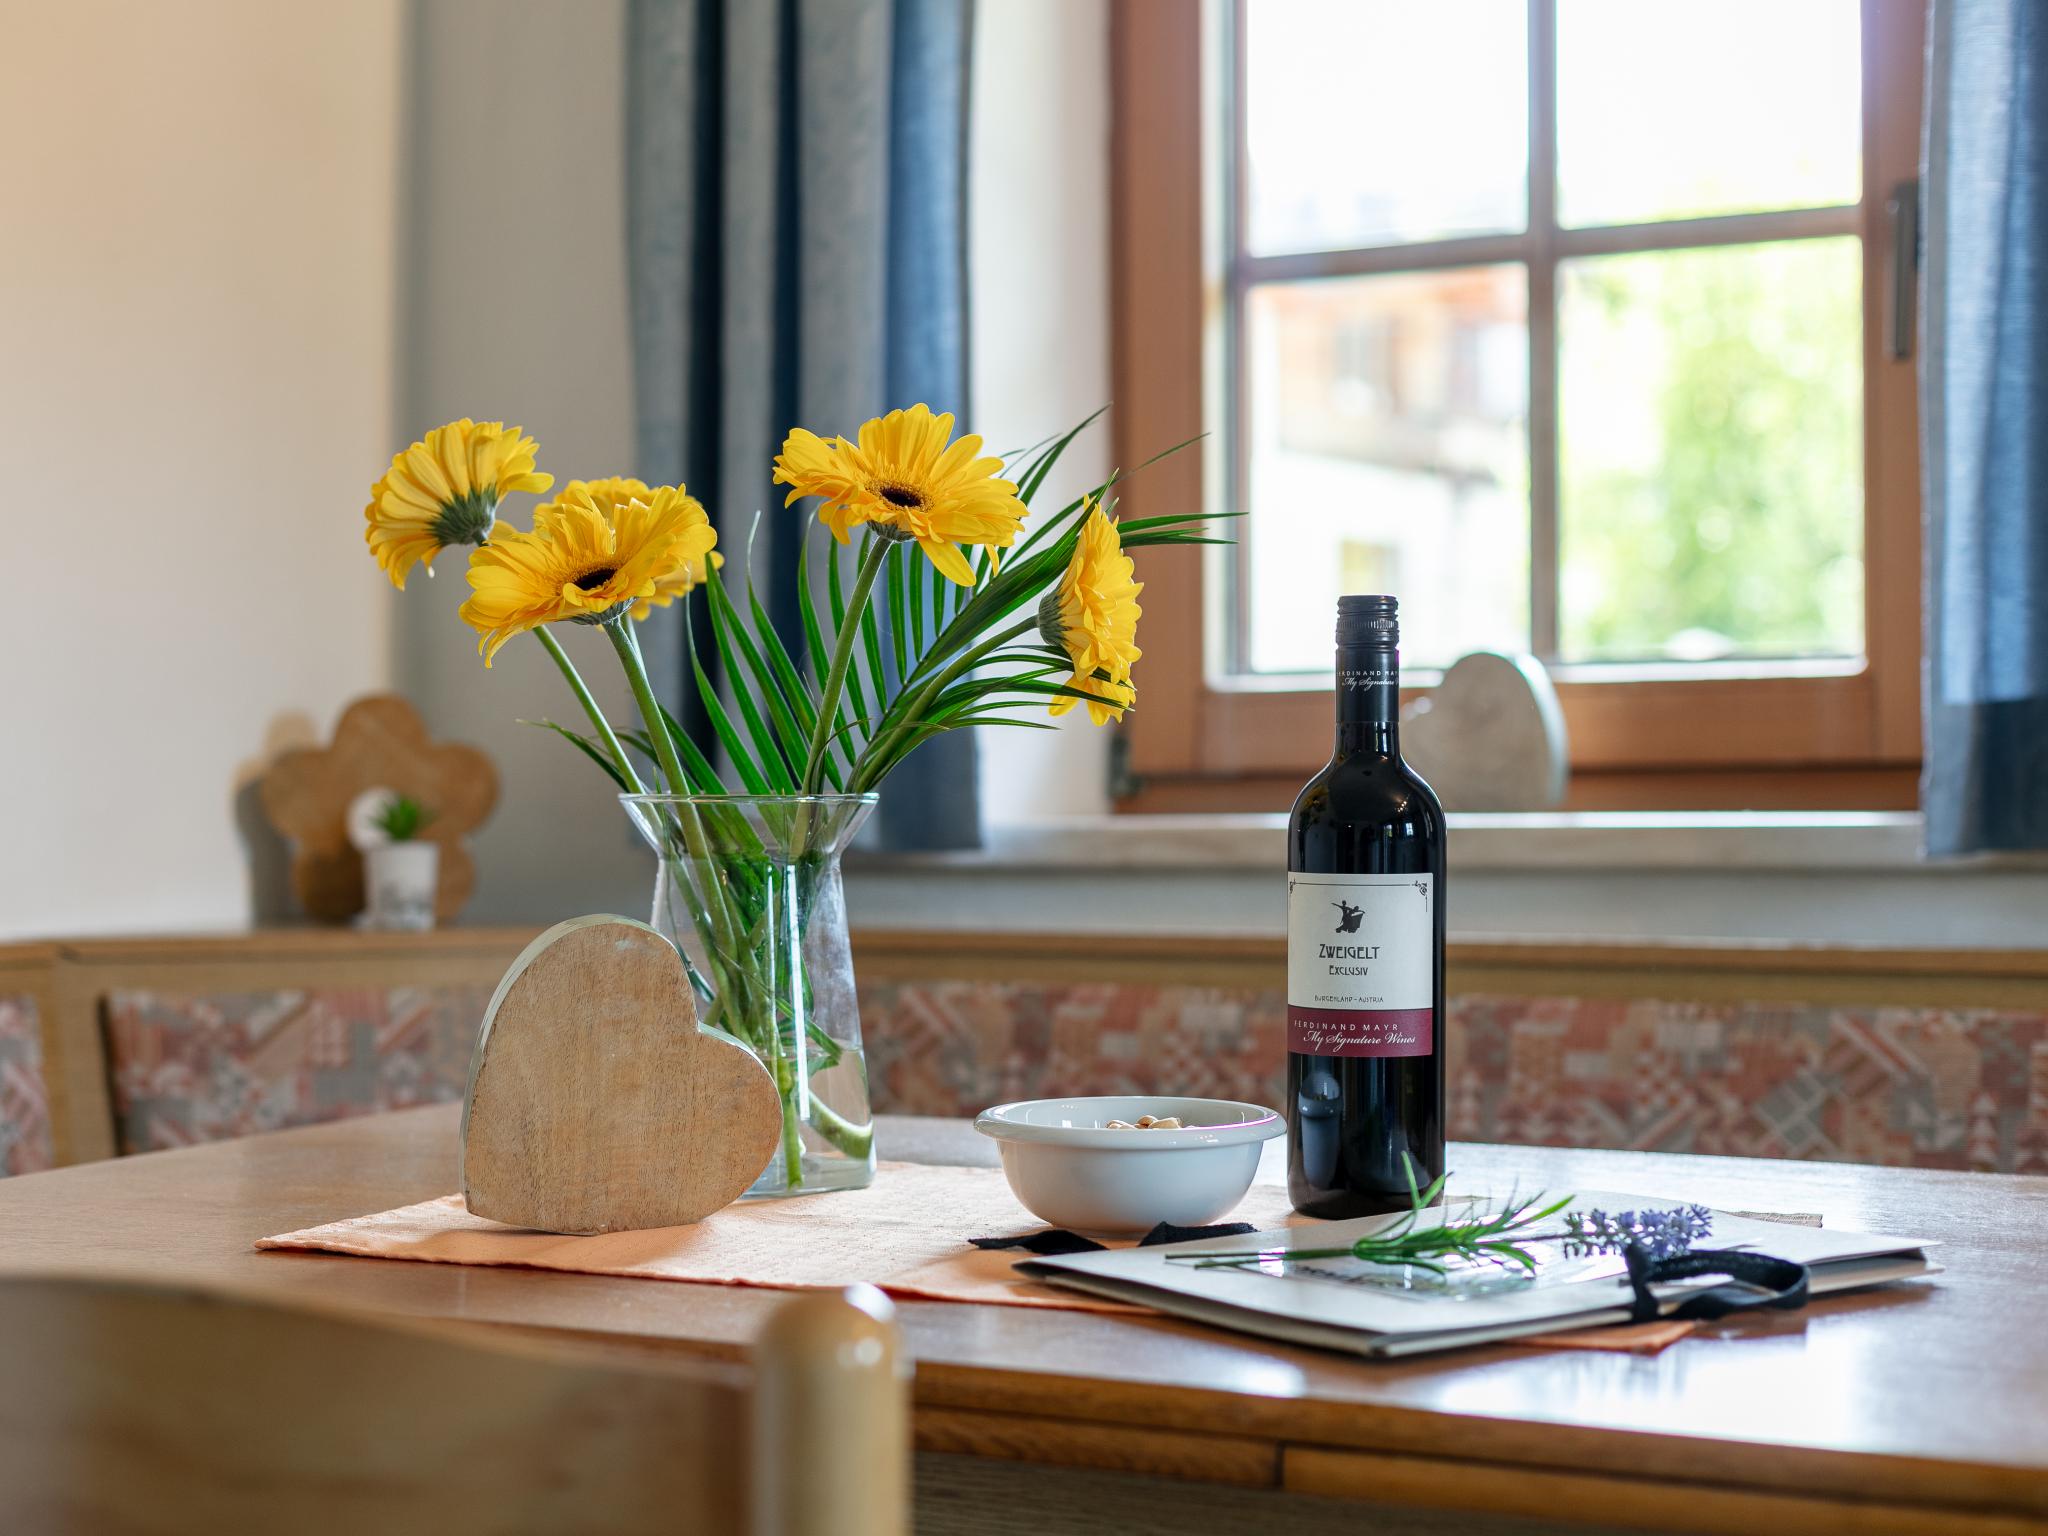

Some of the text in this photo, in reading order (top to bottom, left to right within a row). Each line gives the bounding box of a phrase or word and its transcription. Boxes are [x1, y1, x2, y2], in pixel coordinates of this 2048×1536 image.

[1359, 677, 1394, 691] Signature
[1319, 944, 1380, 959] ZWEIGELT
[1329, 965, 1368, 976] EXCLUSIV
[1294, 1020, 1399, 1031] FERDINAND MAYR
[1303, 1030, 1416, 1052] My Signature Wines
